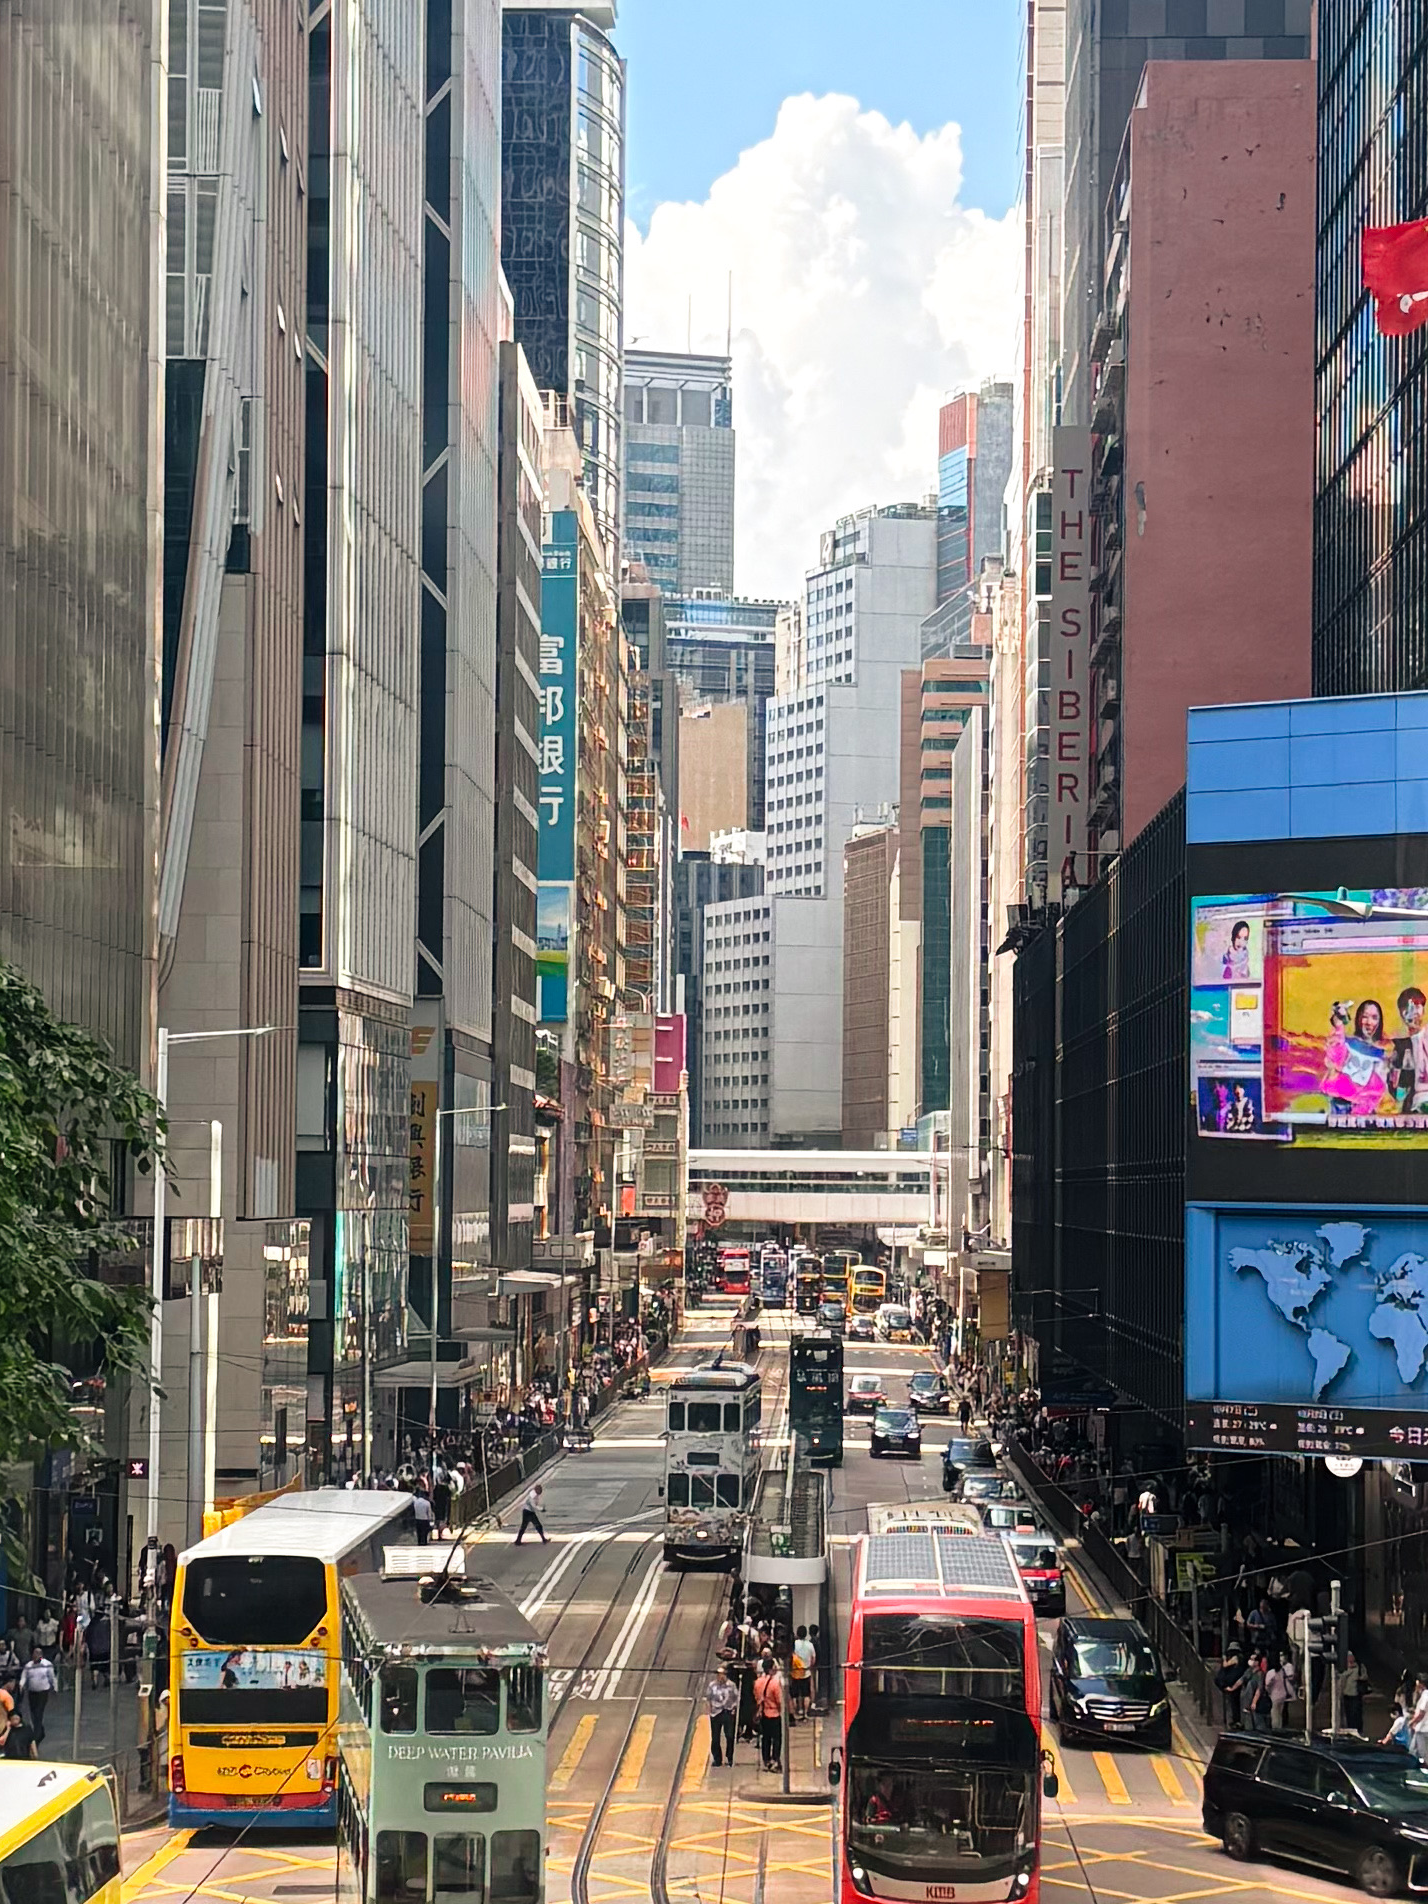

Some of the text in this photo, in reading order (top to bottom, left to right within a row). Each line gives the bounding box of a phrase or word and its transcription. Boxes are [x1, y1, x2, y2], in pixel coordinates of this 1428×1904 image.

[1059, 470, 1084, 581] THE
[388, 1745, 425, 1760] DEEP
[428, 1746, 477, 1761] WATER
